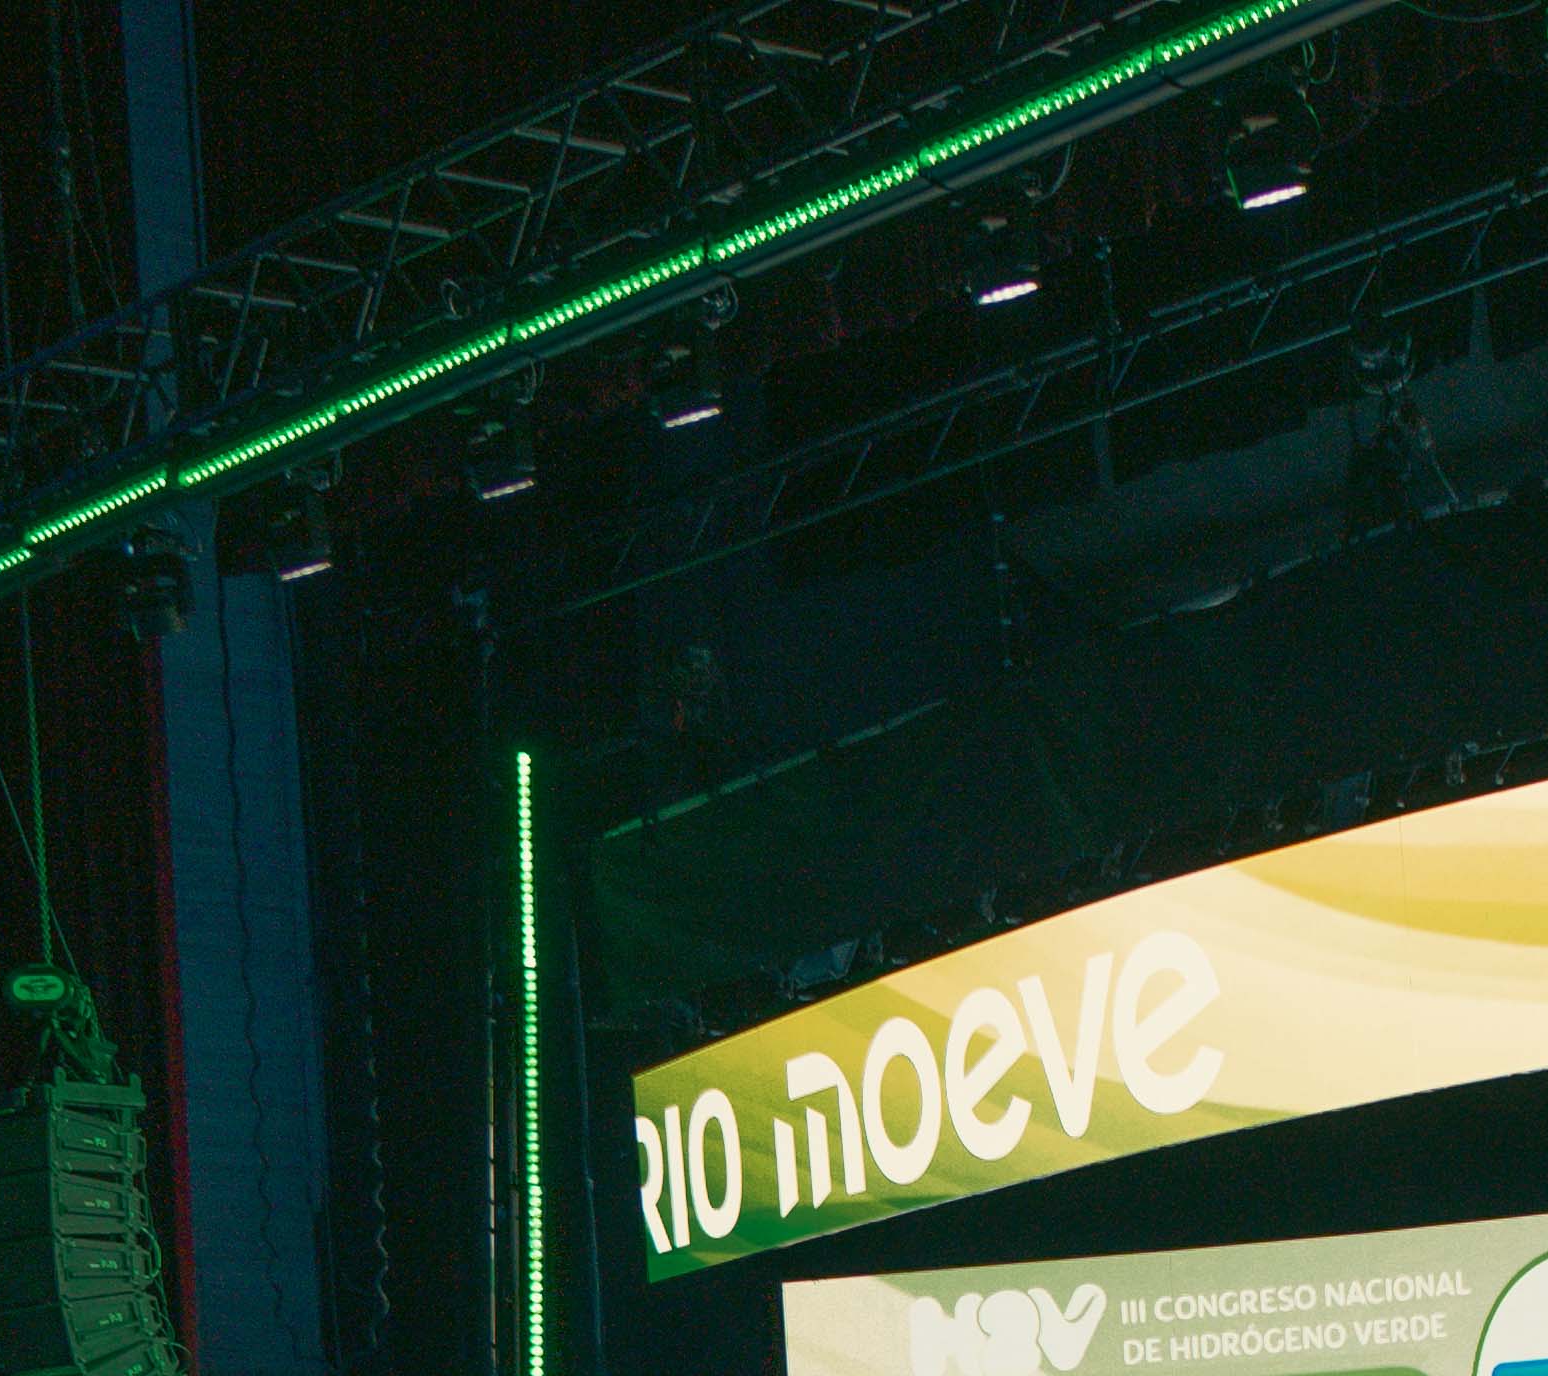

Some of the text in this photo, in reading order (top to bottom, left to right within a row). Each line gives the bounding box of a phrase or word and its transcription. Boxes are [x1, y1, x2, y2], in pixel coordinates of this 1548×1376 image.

[774, 932, 1224, 1218] moeve
[1120, 1271, 1471, 1324] III CONGRESO NACIONAL
[1123, 1311, 1447, 1365] DE HIDRÓGENO VERDE
